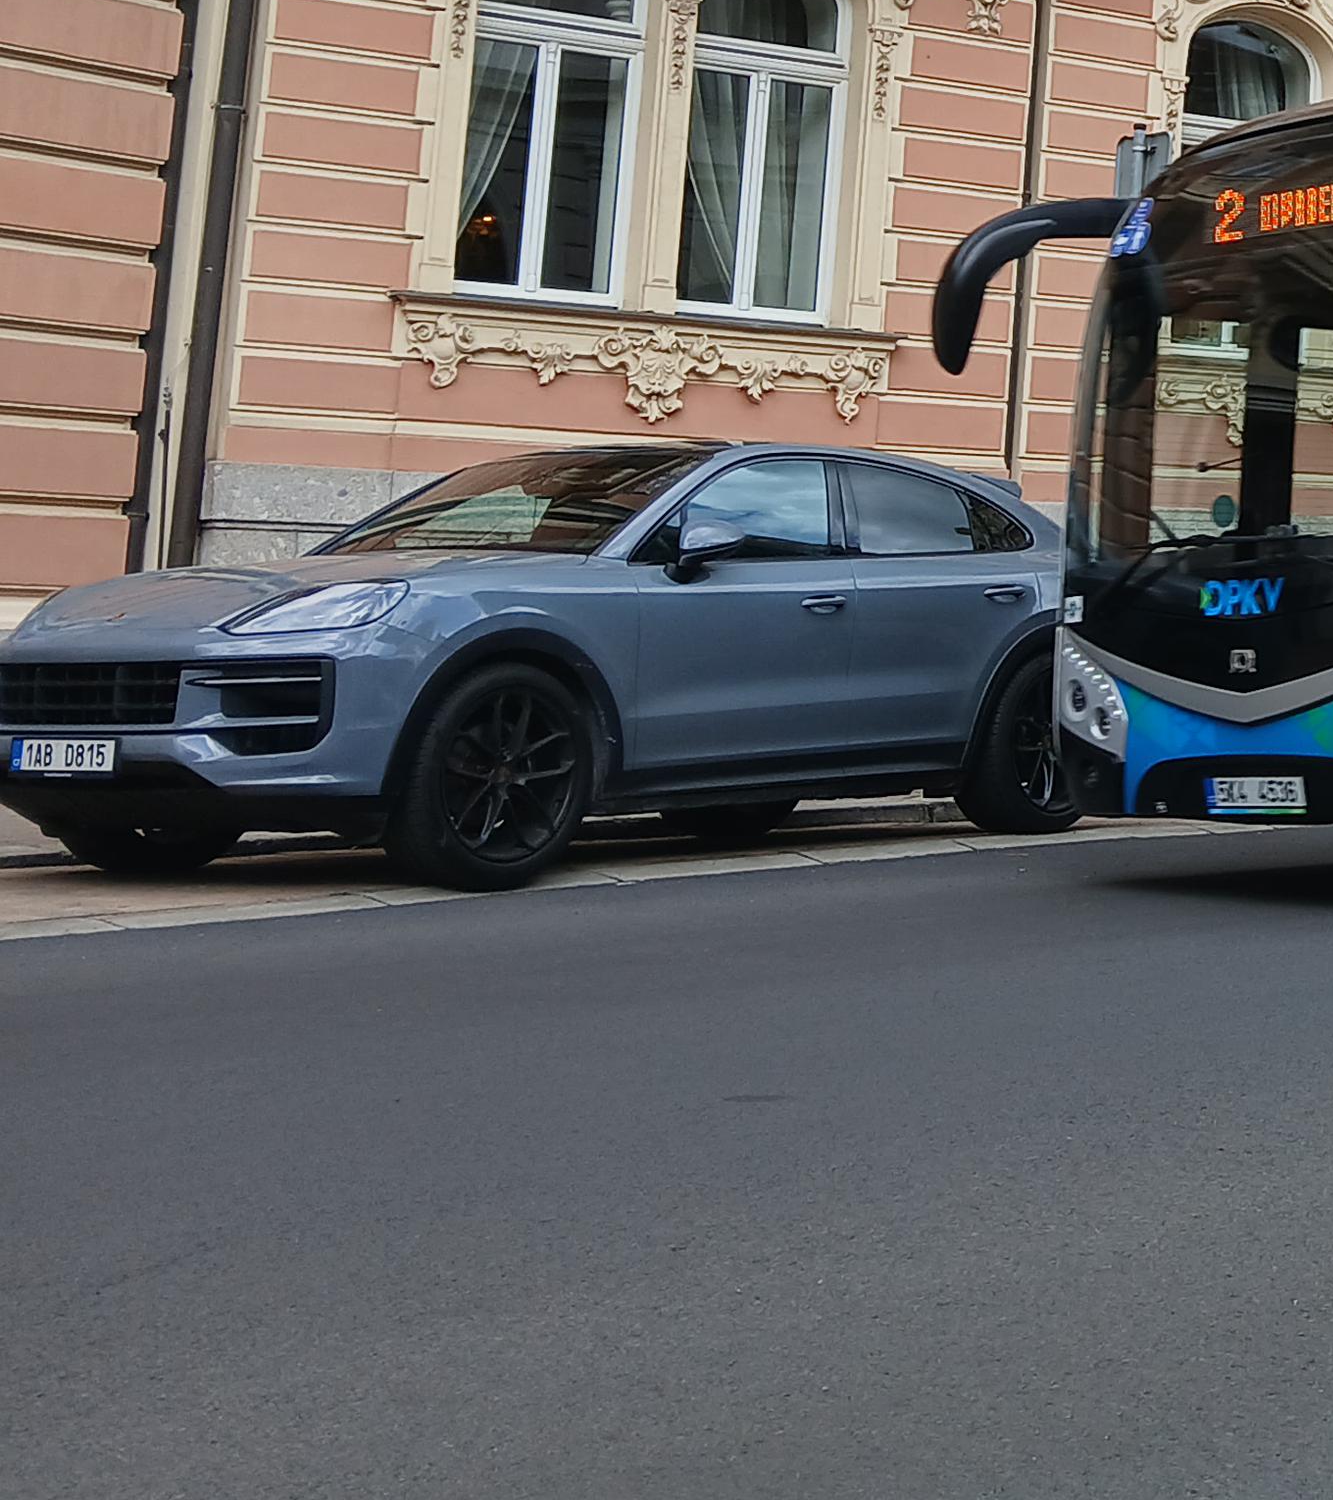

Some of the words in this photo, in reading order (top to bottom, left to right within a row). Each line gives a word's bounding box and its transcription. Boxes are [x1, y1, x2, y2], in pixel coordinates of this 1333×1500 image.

[1213, 188, 1246, 244] 2
[1202, 577, 1286, 617] DPKV
[26, 743, 53, 767] 1AB
[65, 743, 107, 767] D815
